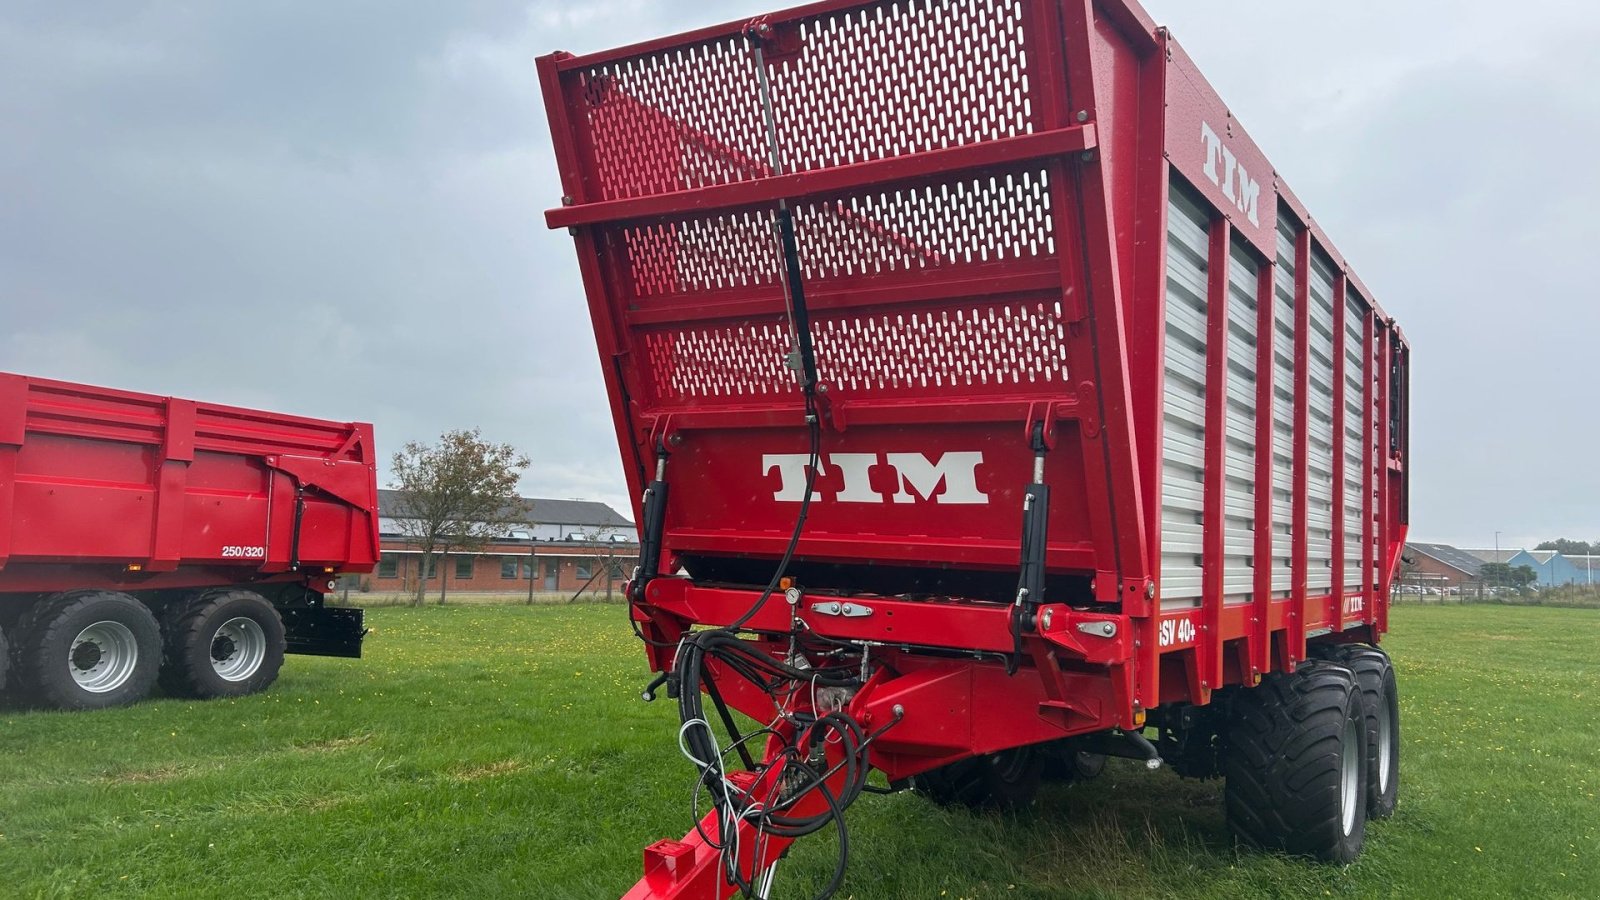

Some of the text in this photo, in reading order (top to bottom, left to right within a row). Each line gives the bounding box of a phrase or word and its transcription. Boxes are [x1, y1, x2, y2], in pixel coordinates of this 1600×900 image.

[1201, 120, 1260, 229] TIM
[762, 451, 989, 504] TIM
[222, 546, 264, 557] 250/320
[1178, 618, 1196, 643] 40+
